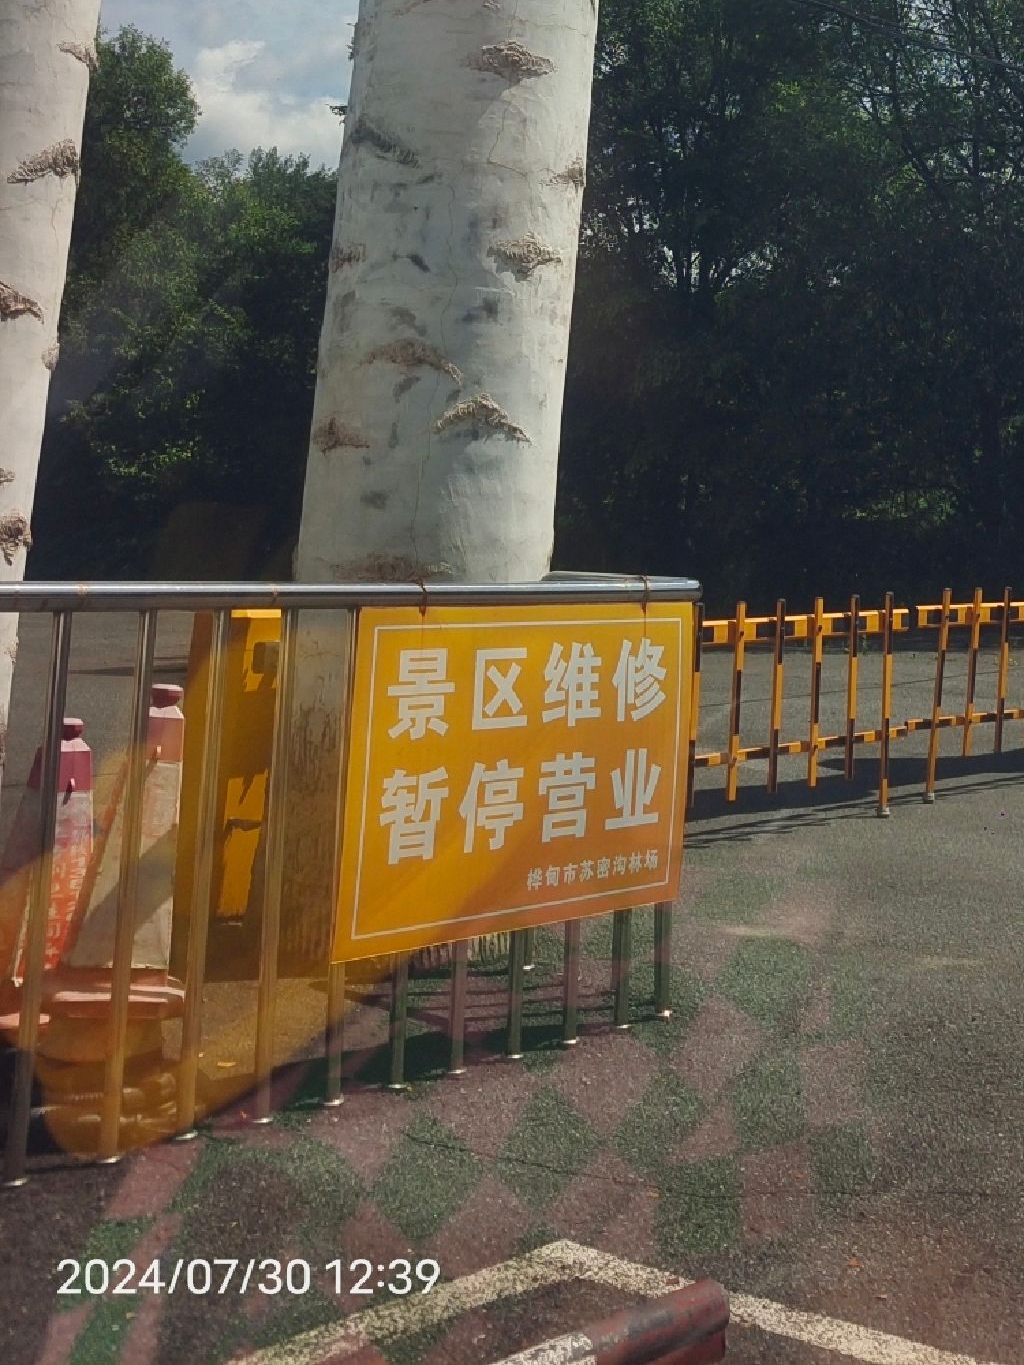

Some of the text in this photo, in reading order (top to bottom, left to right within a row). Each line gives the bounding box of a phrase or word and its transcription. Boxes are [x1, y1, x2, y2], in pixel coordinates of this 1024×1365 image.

[387, 638, 667, 740] 景区维修
[379, 747, 662, 865] 暂停营业
[526, 848, 659, 891] 桦甸市苏密沟林场
